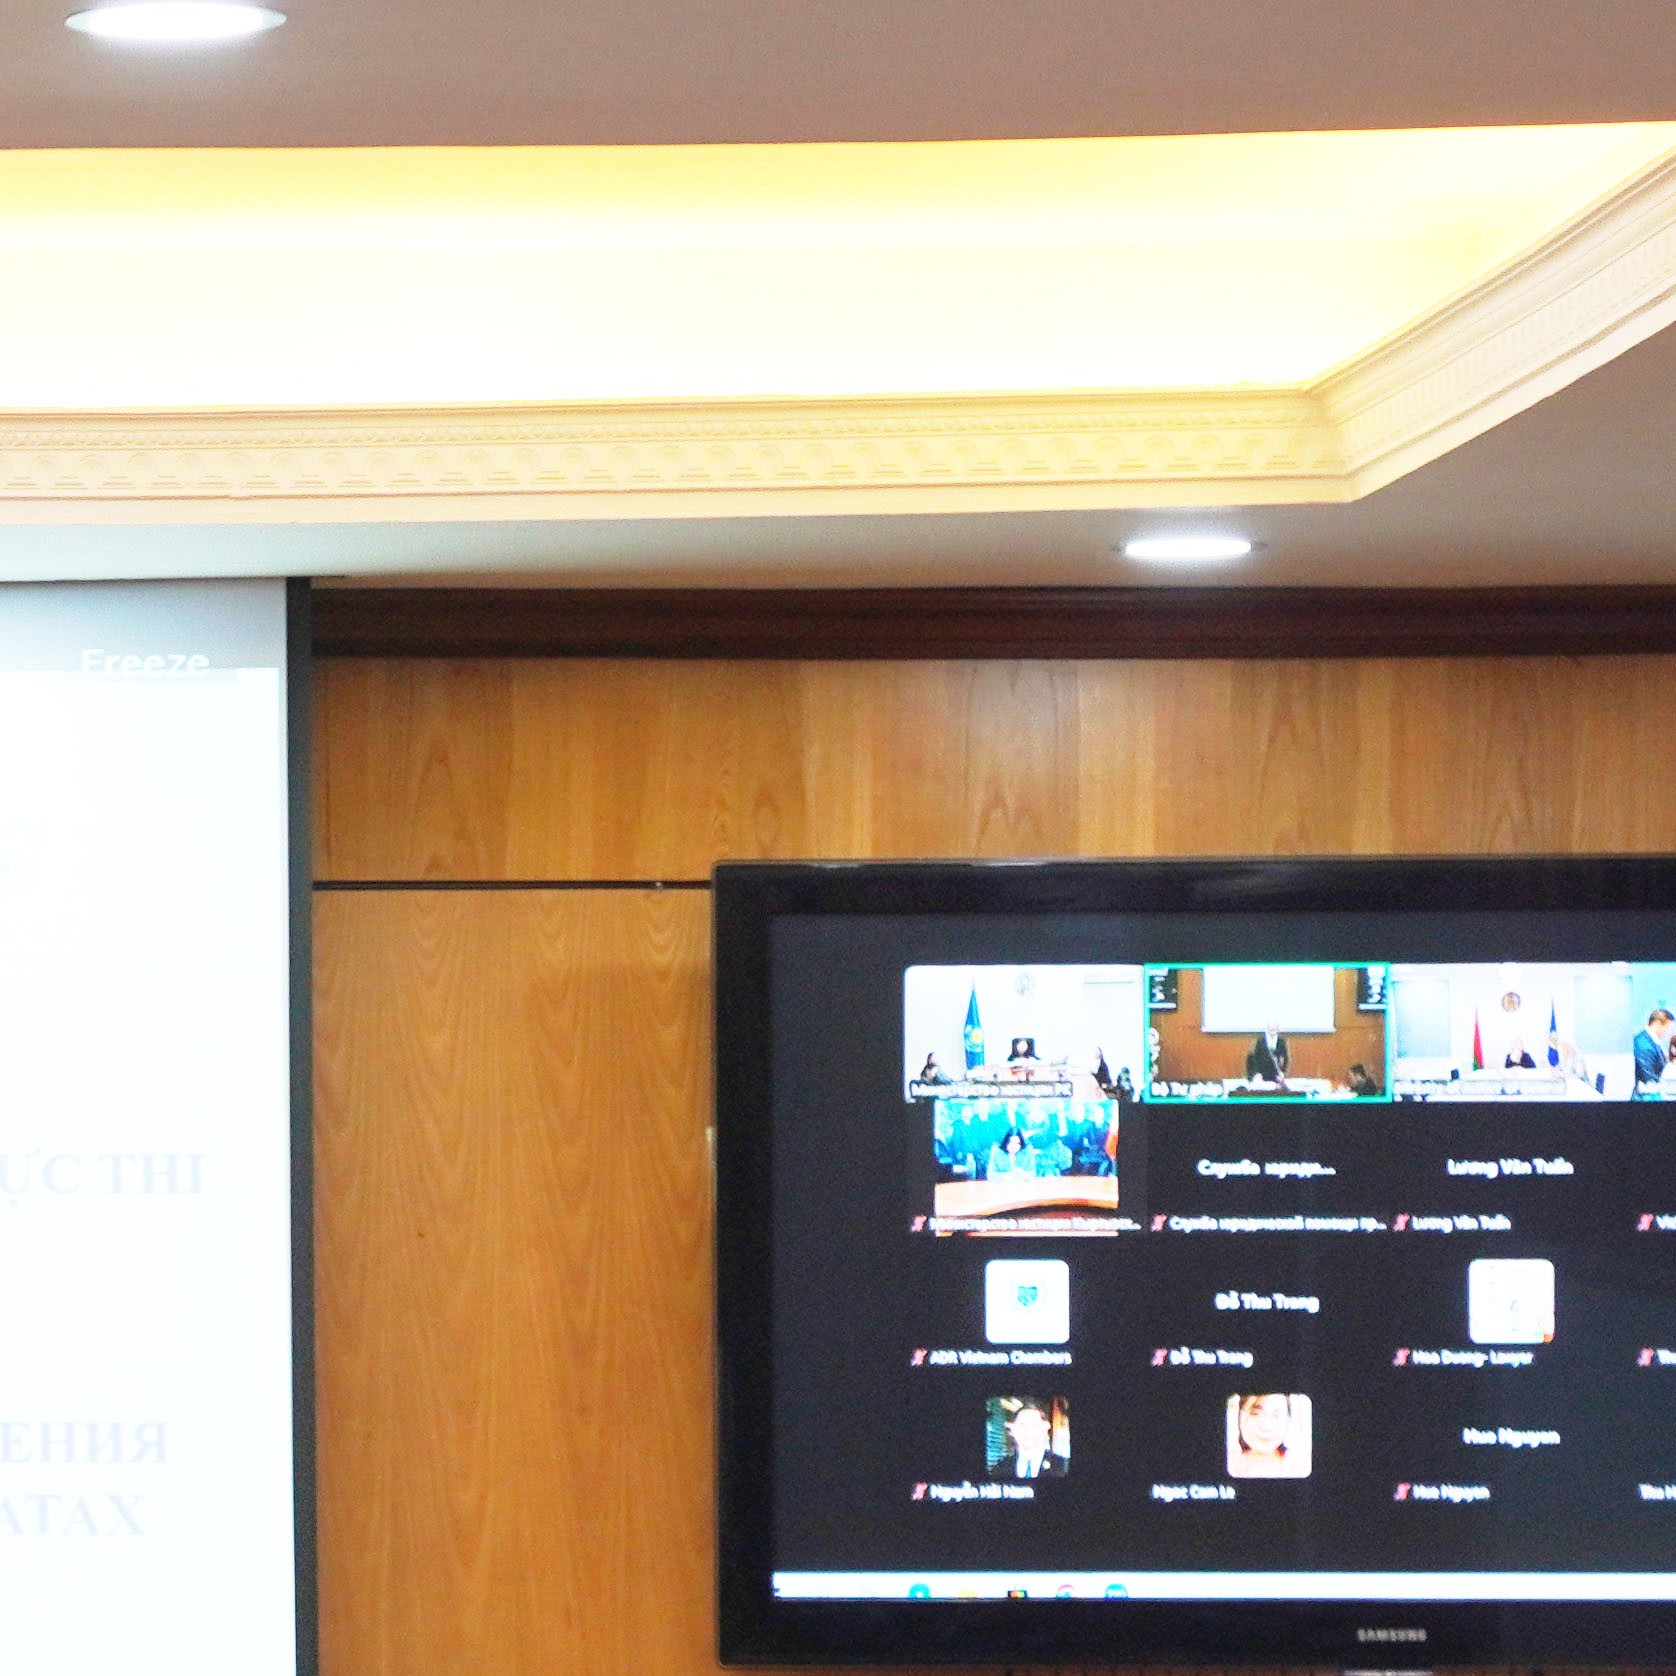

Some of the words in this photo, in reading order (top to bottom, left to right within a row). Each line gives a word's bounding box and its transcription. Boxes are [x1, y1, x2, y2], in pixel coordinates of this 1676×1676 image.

[82, 649, 209, 679] Freeze
[97, 1152, 204, 1196] THI
[1357, 1629, 1427, 1642] SAMSUNG
